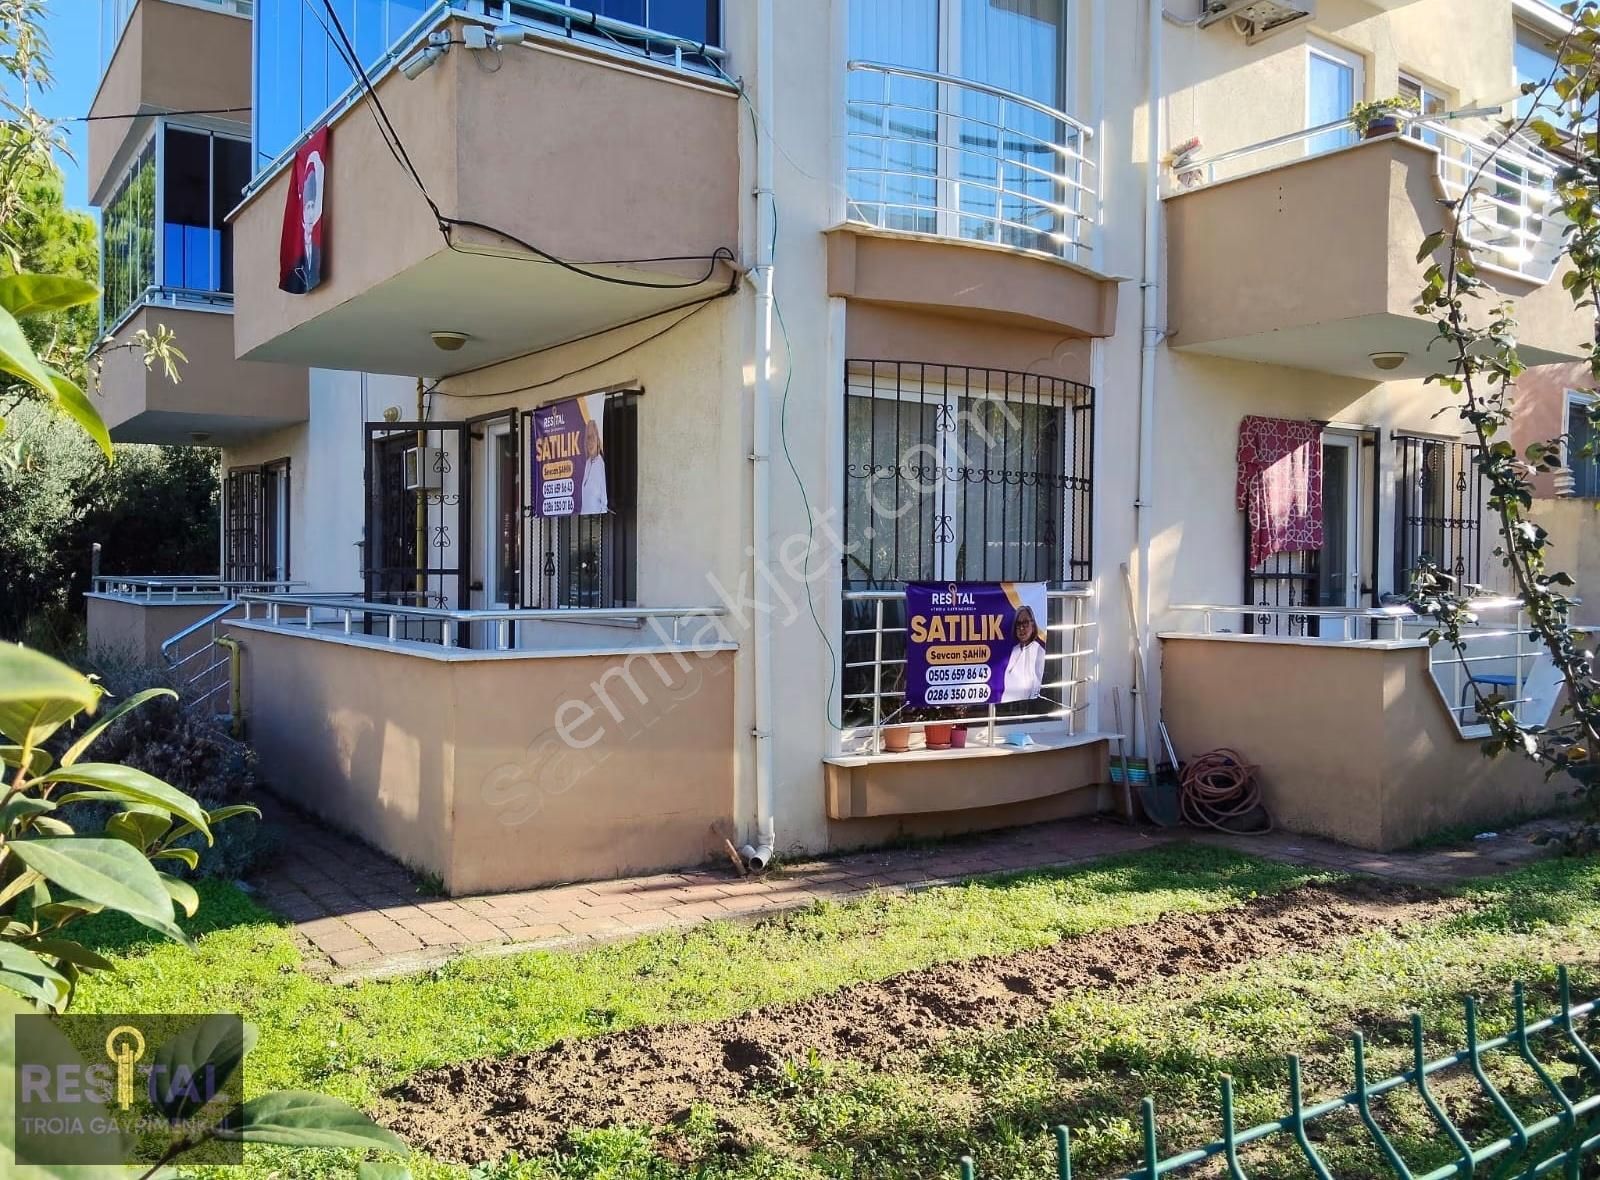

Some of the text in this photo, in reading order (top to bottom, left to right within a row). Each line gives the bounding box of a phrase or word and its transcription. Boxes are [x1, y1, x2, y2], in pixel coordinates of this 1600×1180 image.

[536, 431, 580, 461] SATILIK
[911, 614, 1004, 643] SATILIK
[930, 647, 987, 661] Sevcan ŞAHİN
[929, 667, 988, 681] 0505 659 86 43
[927, 687, 989, 701] 0286 350 01 86
